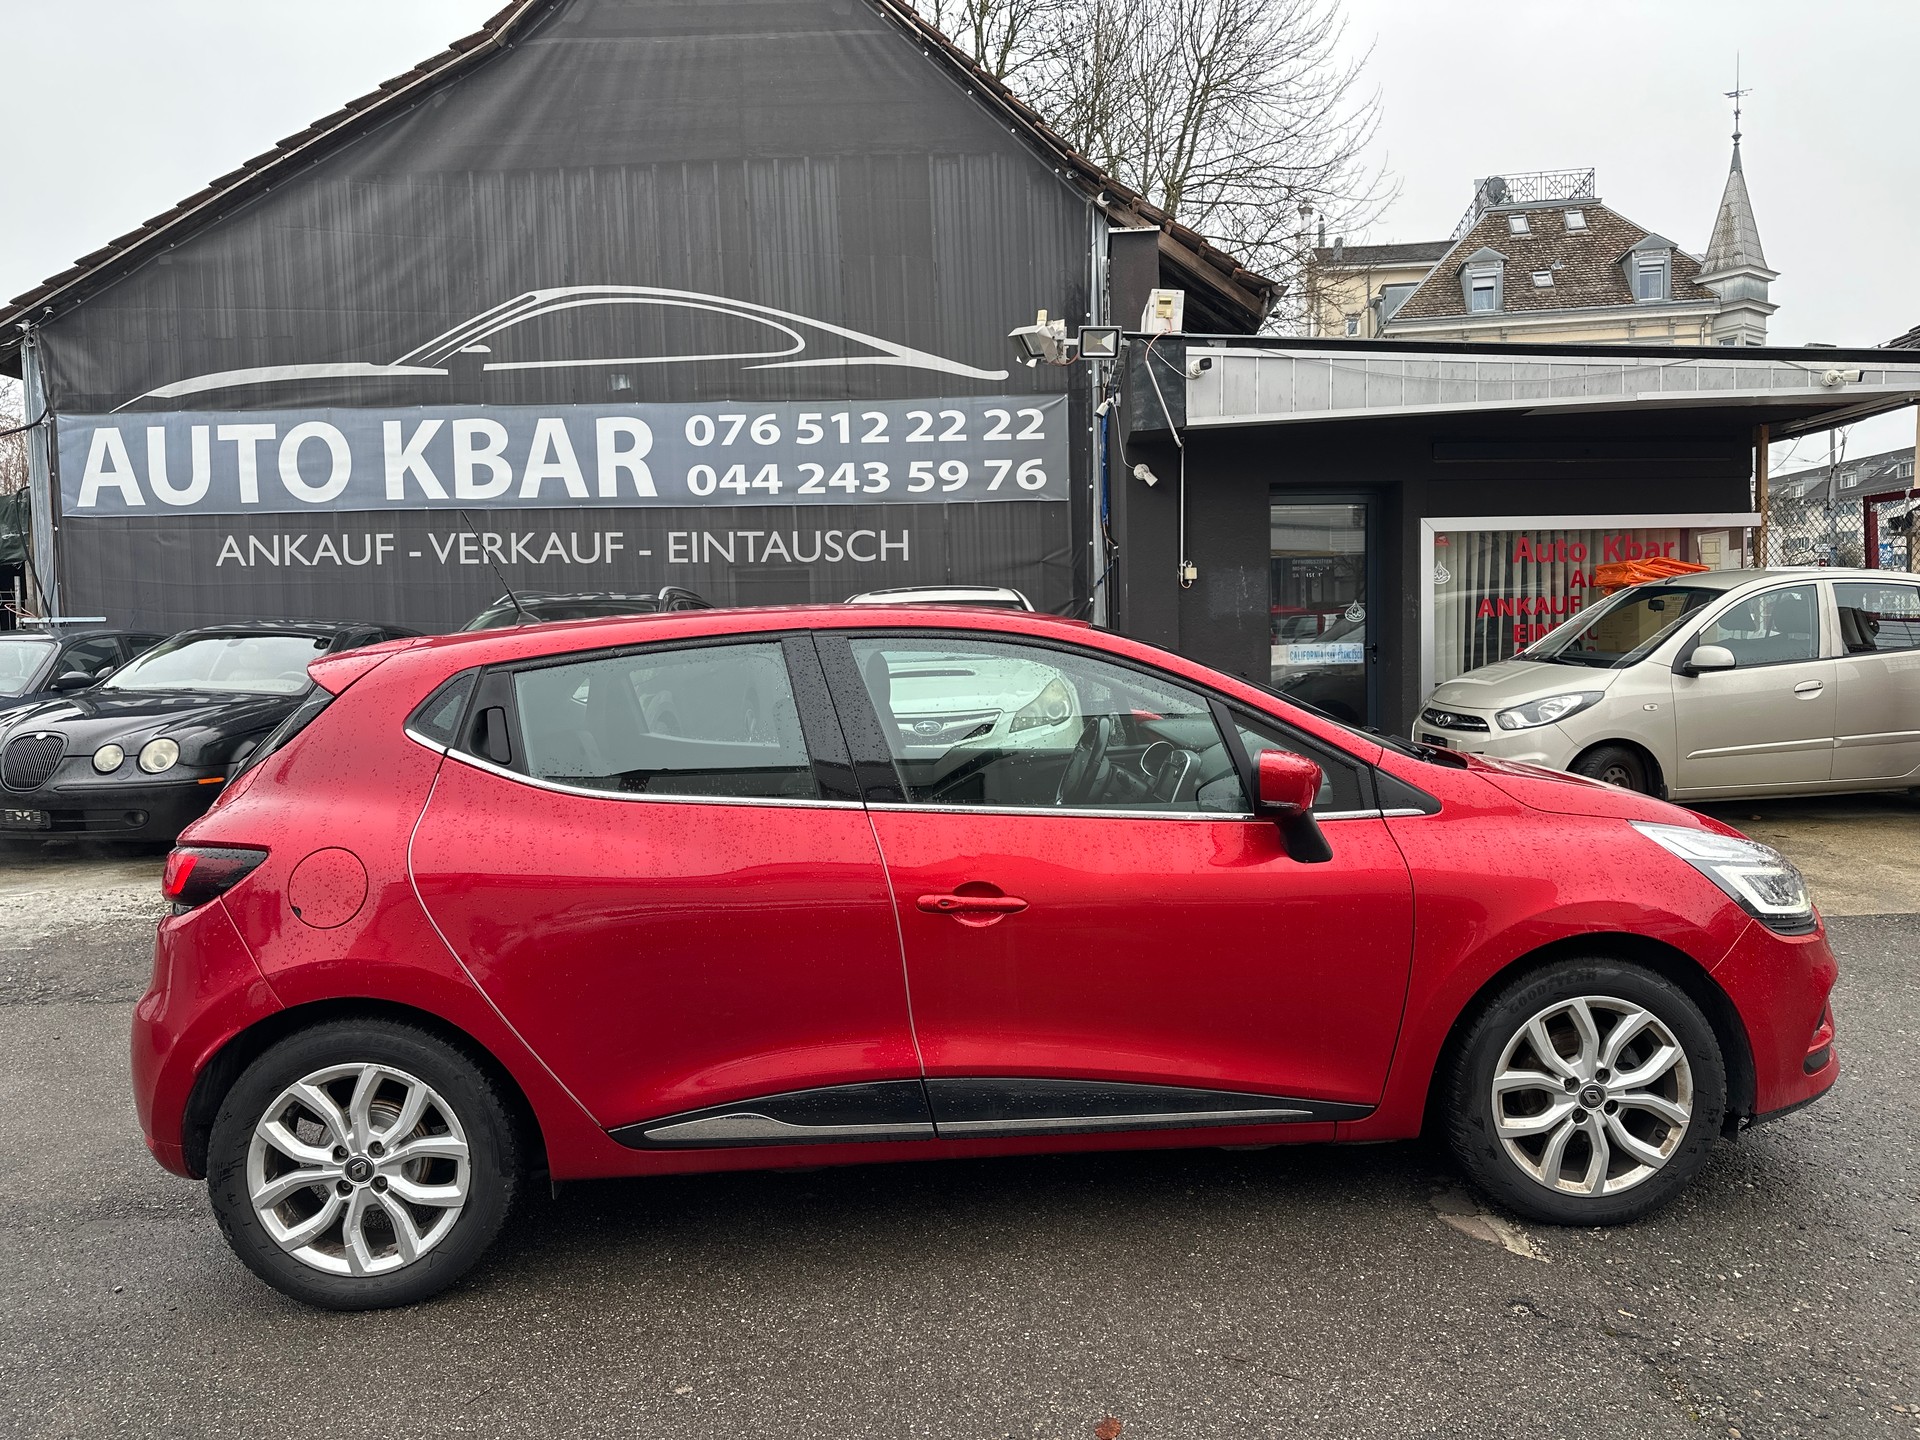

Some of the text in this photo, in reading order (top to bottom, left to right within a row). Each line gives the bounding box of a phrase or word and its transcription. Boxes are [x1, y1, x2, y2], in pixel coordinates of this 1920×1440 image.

[685, 408, 1045, 447] 076 512 22 22
[76, 416, 658, 507] AUTO KBAR
[686, 458, 1047, 496] 044 243 59 76
[216, 533, 395, 567] ANKAUF
[668, 529, 909, 563] EINTAUSCH
[1513, 534, 1675, 563] Auto Kbar
[1477, 595, 1583, 617] ANKAUF
